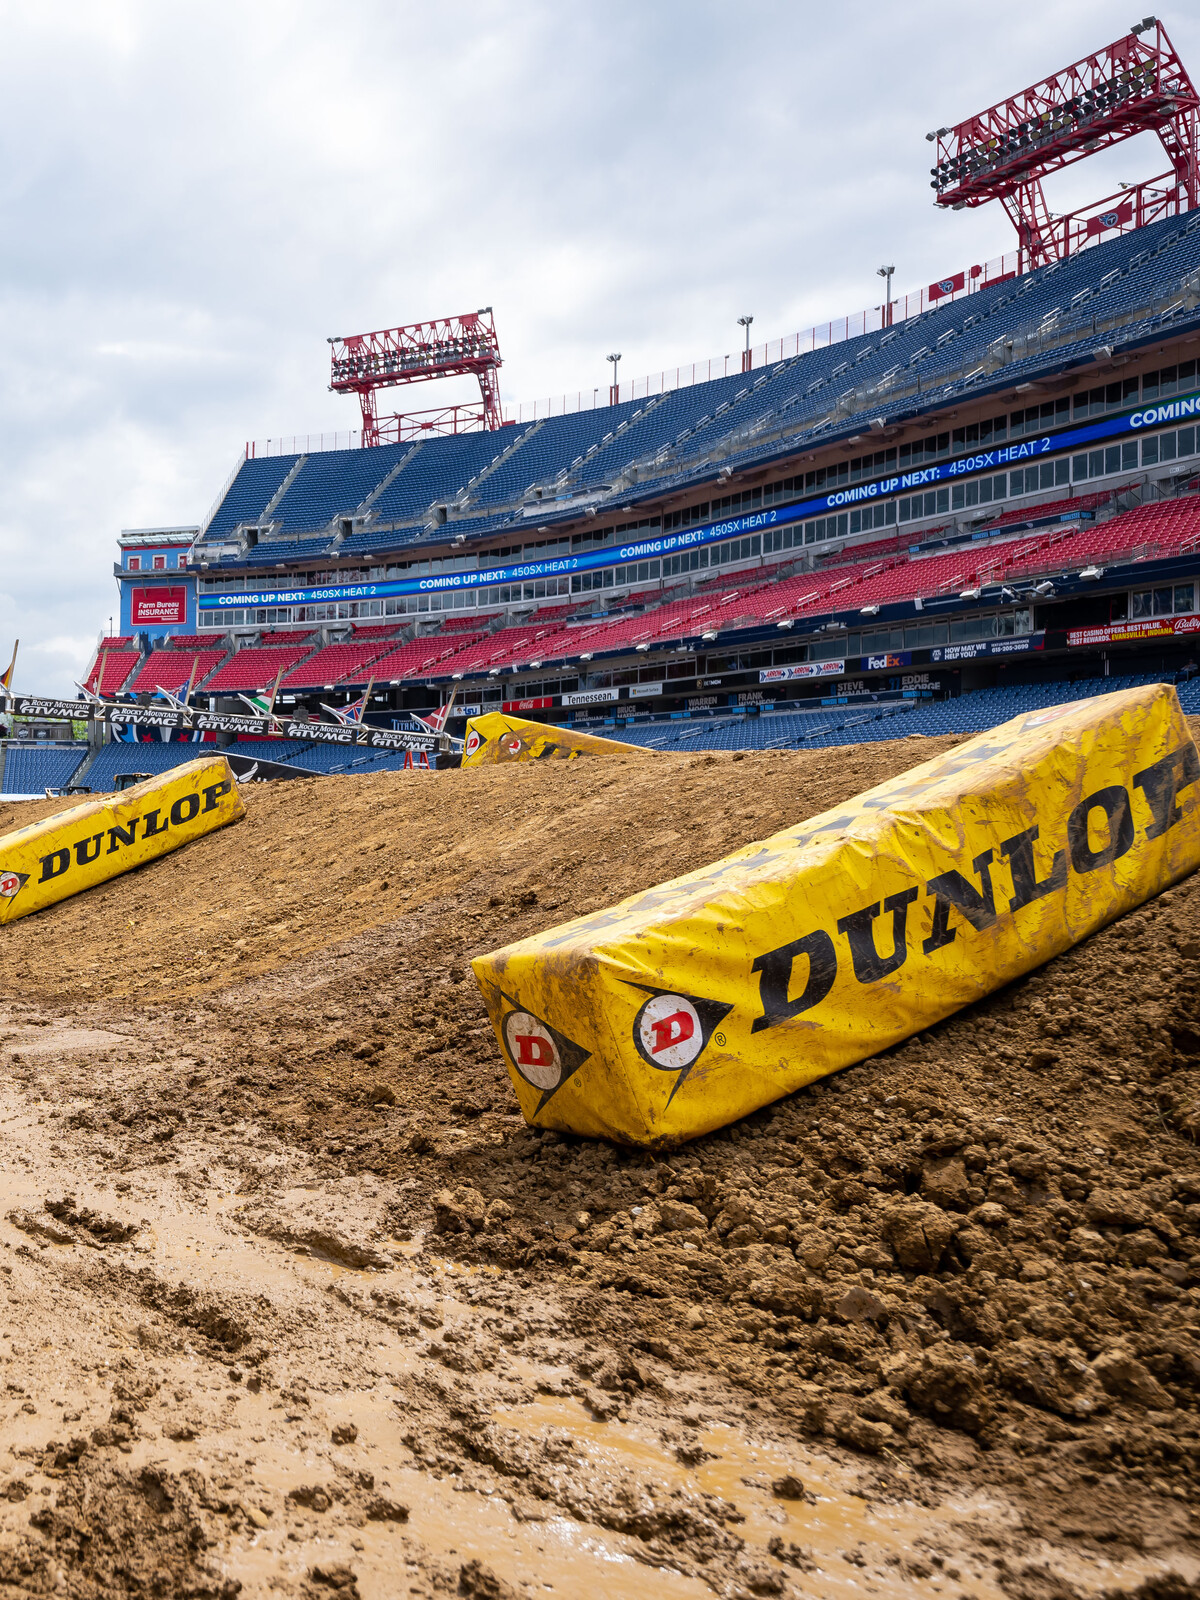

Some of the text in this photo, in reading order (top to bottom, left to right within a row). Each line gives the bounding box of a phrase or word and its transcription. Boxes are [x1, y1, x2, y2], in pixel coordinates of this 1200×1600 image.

[826, 437, 1050, 507] COMING UP NEXT: 450SX HEAT 2
[620, 510, 777, 558] COMING UP NEXT: 450SX HEAT 2
[420, 558, 578, 590] COMING UP NEXT: 450SX HEAT 2
[219, 586, 376, 605] COMING UP NEXT: 450SX HEAT 2
[137, 608, 178, 616] INSURANCE
[1069, 631, 1082, 639] BEST
[1083, 629, 1103, 637] CASINO
[1127, 624, 1141, 632] BEST
[945, 646, 960, 654] HOW
[961, 644, 975, 652] MAY
[867, 653, 900, 669] FedEx
[945, 652, 959, 660] HELP
[902, 674, 929, 685] EDDIE
[837, 681, 864, 692] STEVE
[688, 696, 718, 706] WARREN
[738, 692, 764, 702] FRANK
[54, 701, 90, 710] MOUNTAIN
[617, 705, 637, 713] BRUCE
[144, 710, 178, 718] MOUNTAIN
[230, 717, 265, 726] MOUNTAIN
[299, 723, 352, 734] ROCKY MOUNTAIN
[403, 734, 435, 743] MOUNTAIN
[37, 780, 231, 884] DUNLOP
[751, 733, 1200, 1034] DUNLOP
